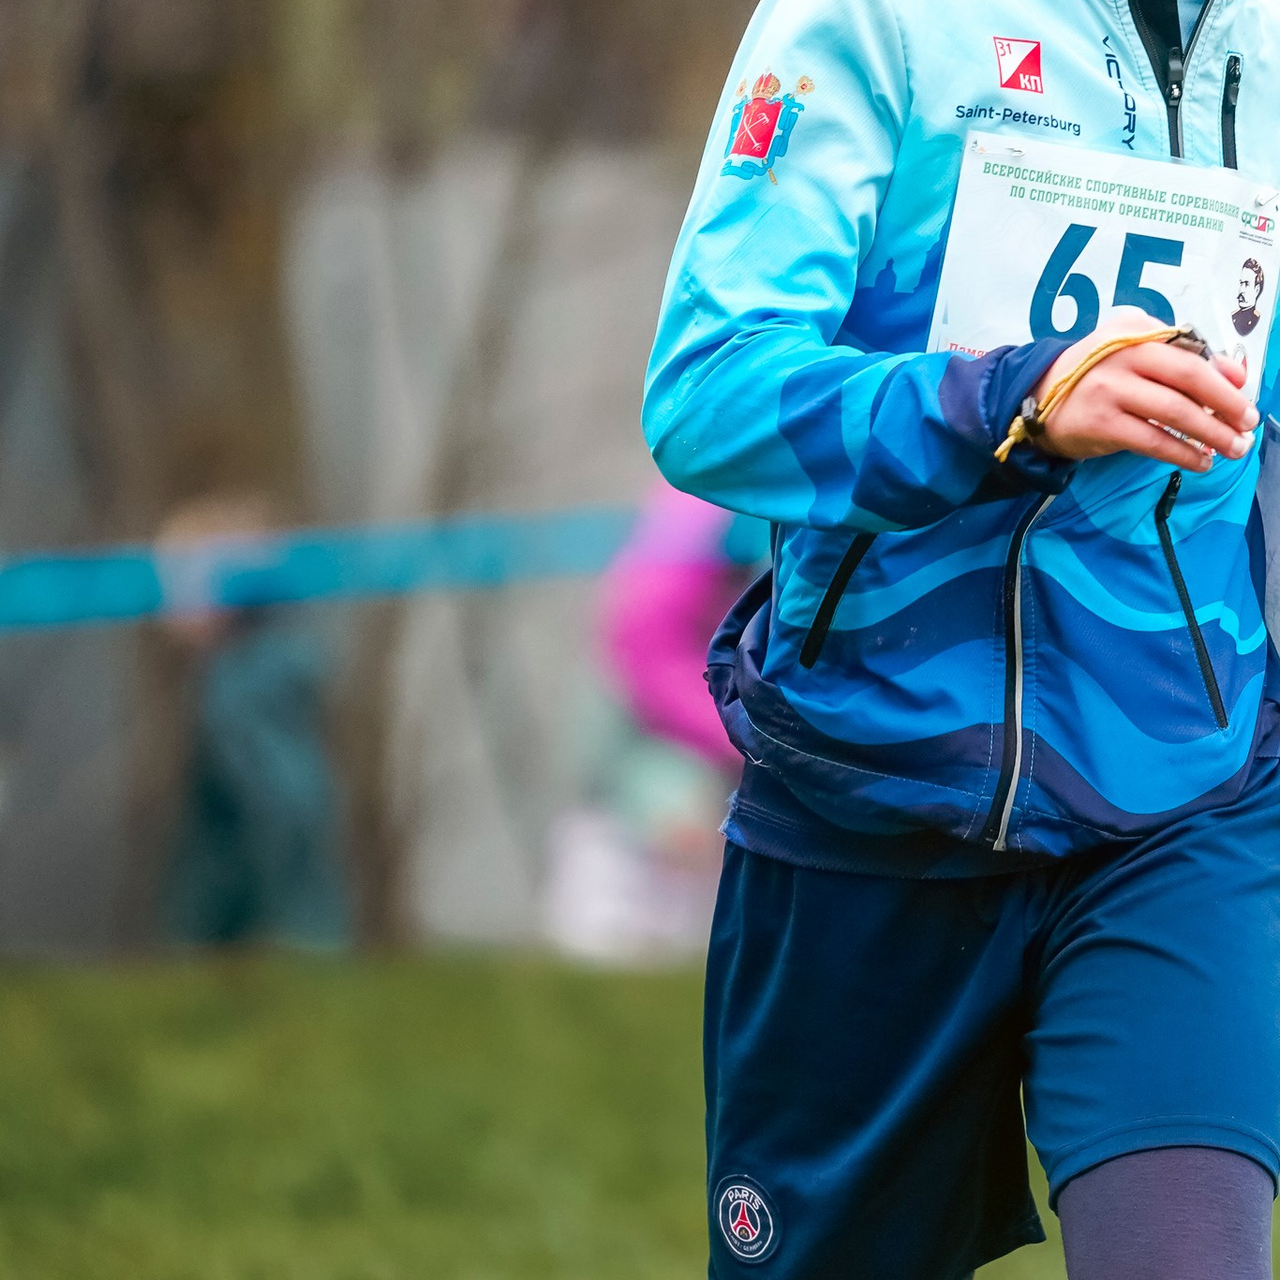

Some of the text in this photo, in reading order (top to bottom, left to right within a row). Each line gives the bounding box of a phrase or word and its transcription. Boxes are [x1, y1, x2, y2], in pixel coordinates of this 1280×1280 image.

[997, 41, 1012, 57] 31
[1019, 73, 1041, 92] КП
[955, 105, 1081, 136] Saint-Petersburg
[983, 161, 1082, 190] ВСЕРОССИЙСКИЕ
[1086, 179, 1167, 204] СПОРТИВНЫЕ
[1009, 185, 1026, 199] ПО
[1029, 188, 1115, 214] СПОРТИВНОМУ
[1029, 223, 1184, 343] 65
[728, 1189, 761, 1211] PARIS
